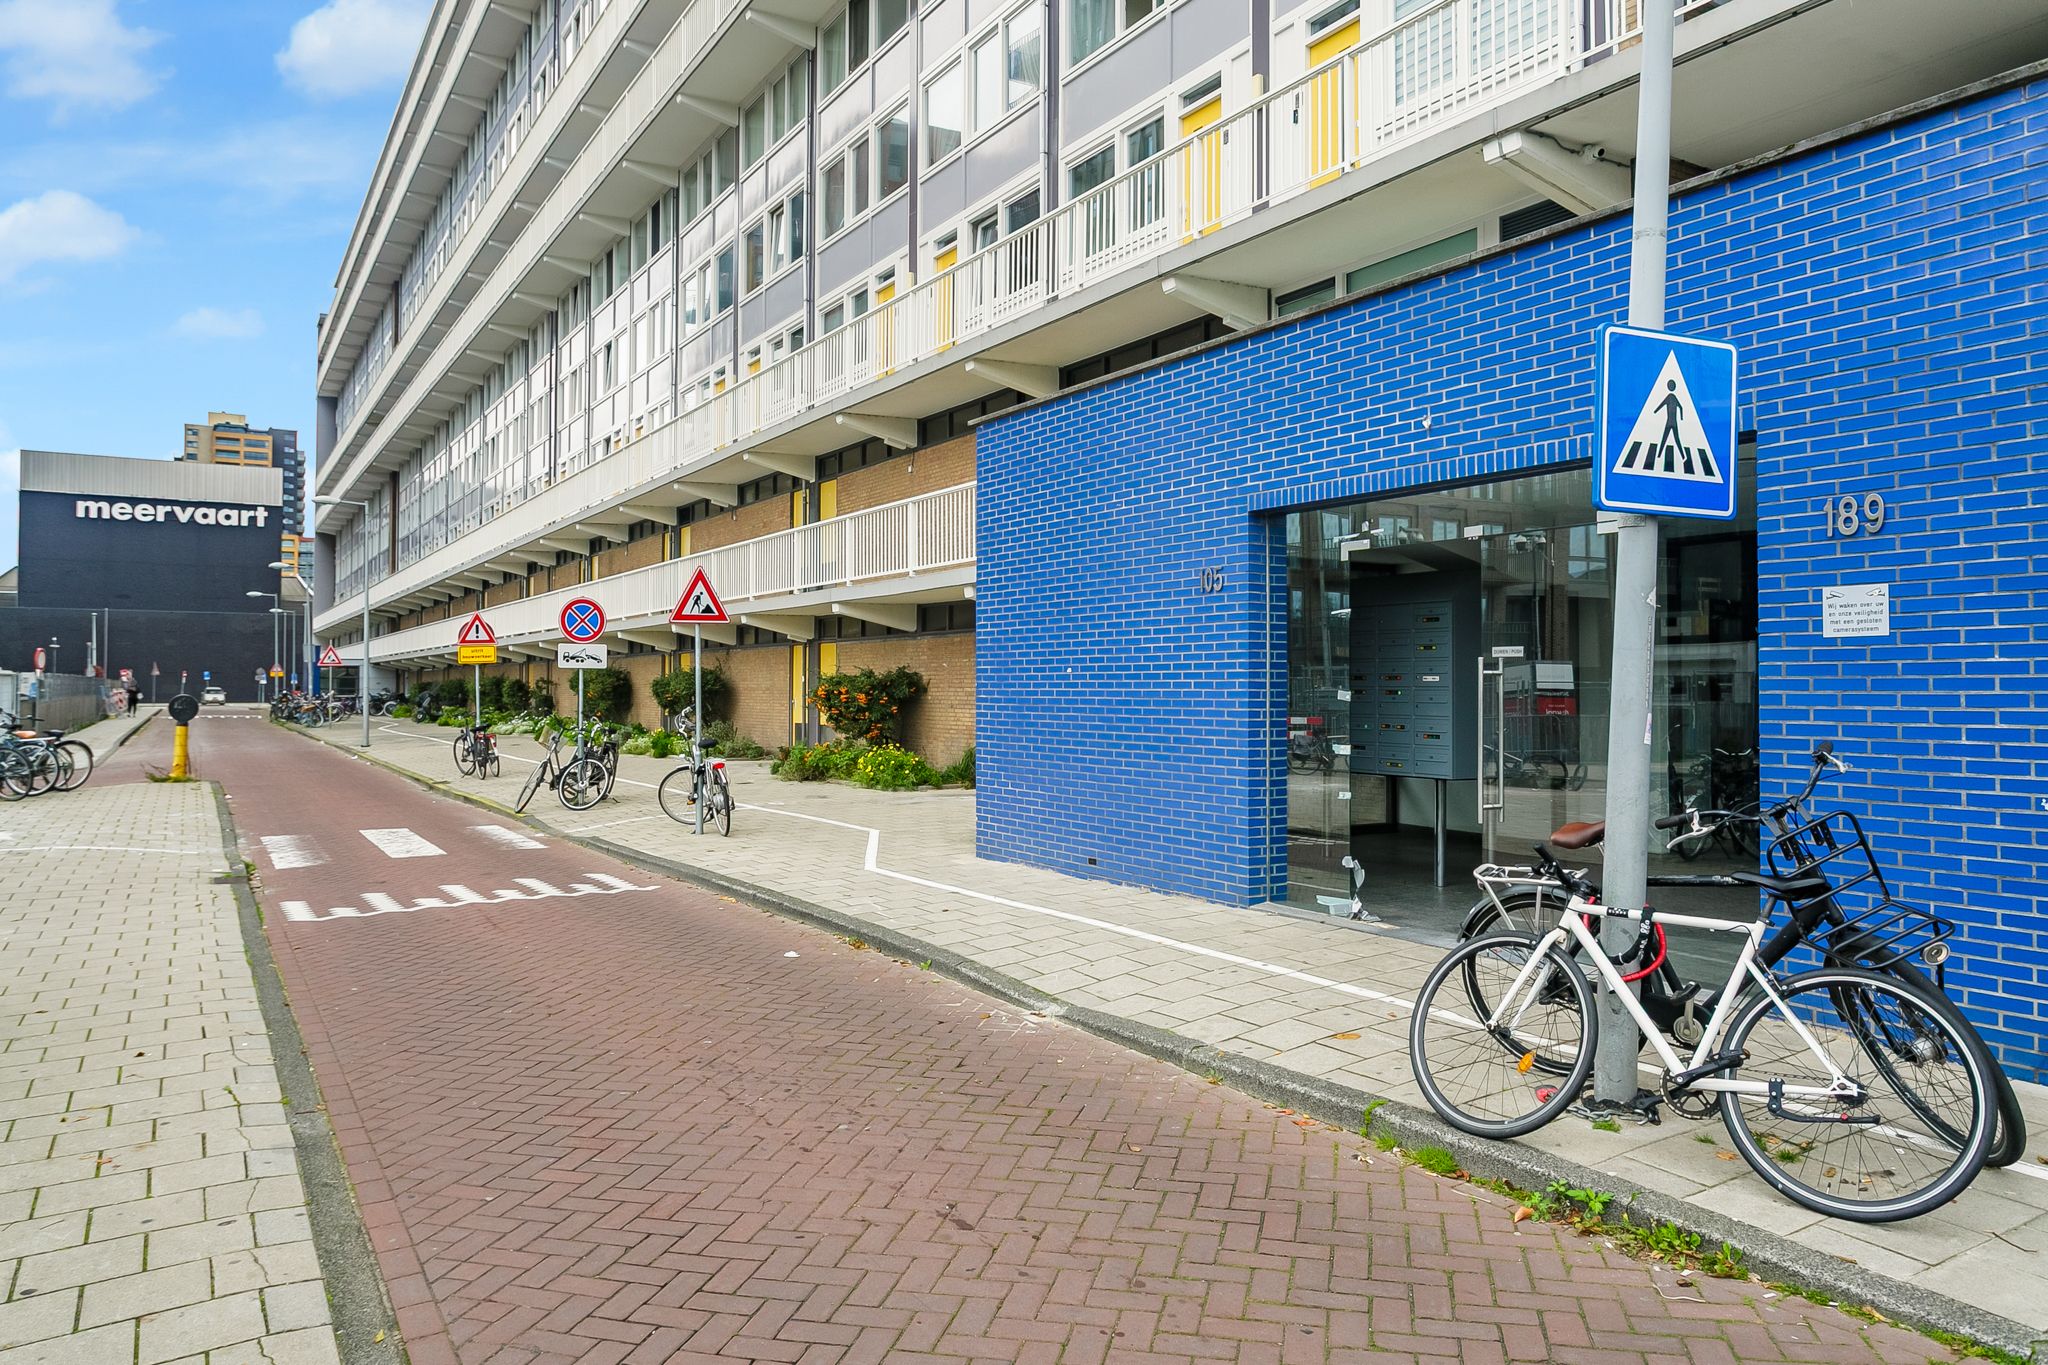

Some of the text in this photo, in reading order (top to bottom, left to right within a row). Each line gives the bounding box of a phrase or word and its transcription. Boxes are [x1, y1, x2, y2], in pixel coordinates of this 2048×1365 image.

[75, 500, 269, 528] meervaart
[1823, 492, 1885, 537] 189
[1200, 566, 1222, 592] 105
[1854, 609, 1884, 617] veiligheid
[1856, 618, 1882, 626] gesloten
